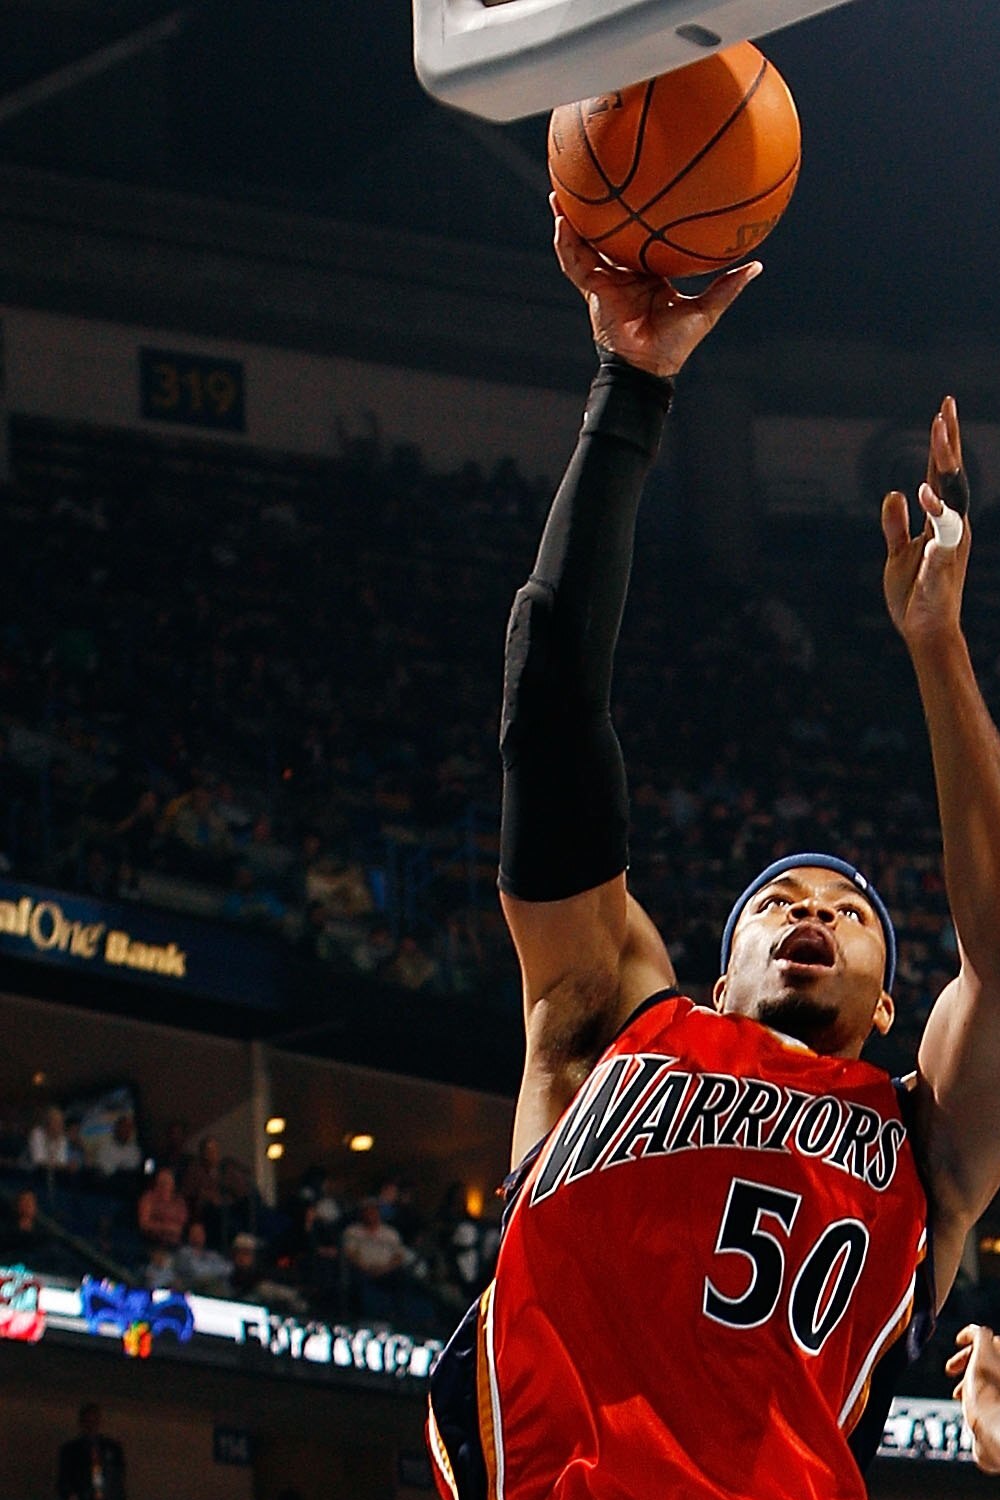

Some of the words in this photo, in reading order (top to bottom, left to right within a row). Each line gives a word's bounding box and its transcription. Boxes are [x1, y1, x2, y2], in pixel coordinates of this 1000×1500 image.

[150, 361, 237, 415] 319
[104, 929, 187, 978] Bank
[527, 1052, 907, 1208] WARRIORS
[702, 1176, 871, 1357] 50
